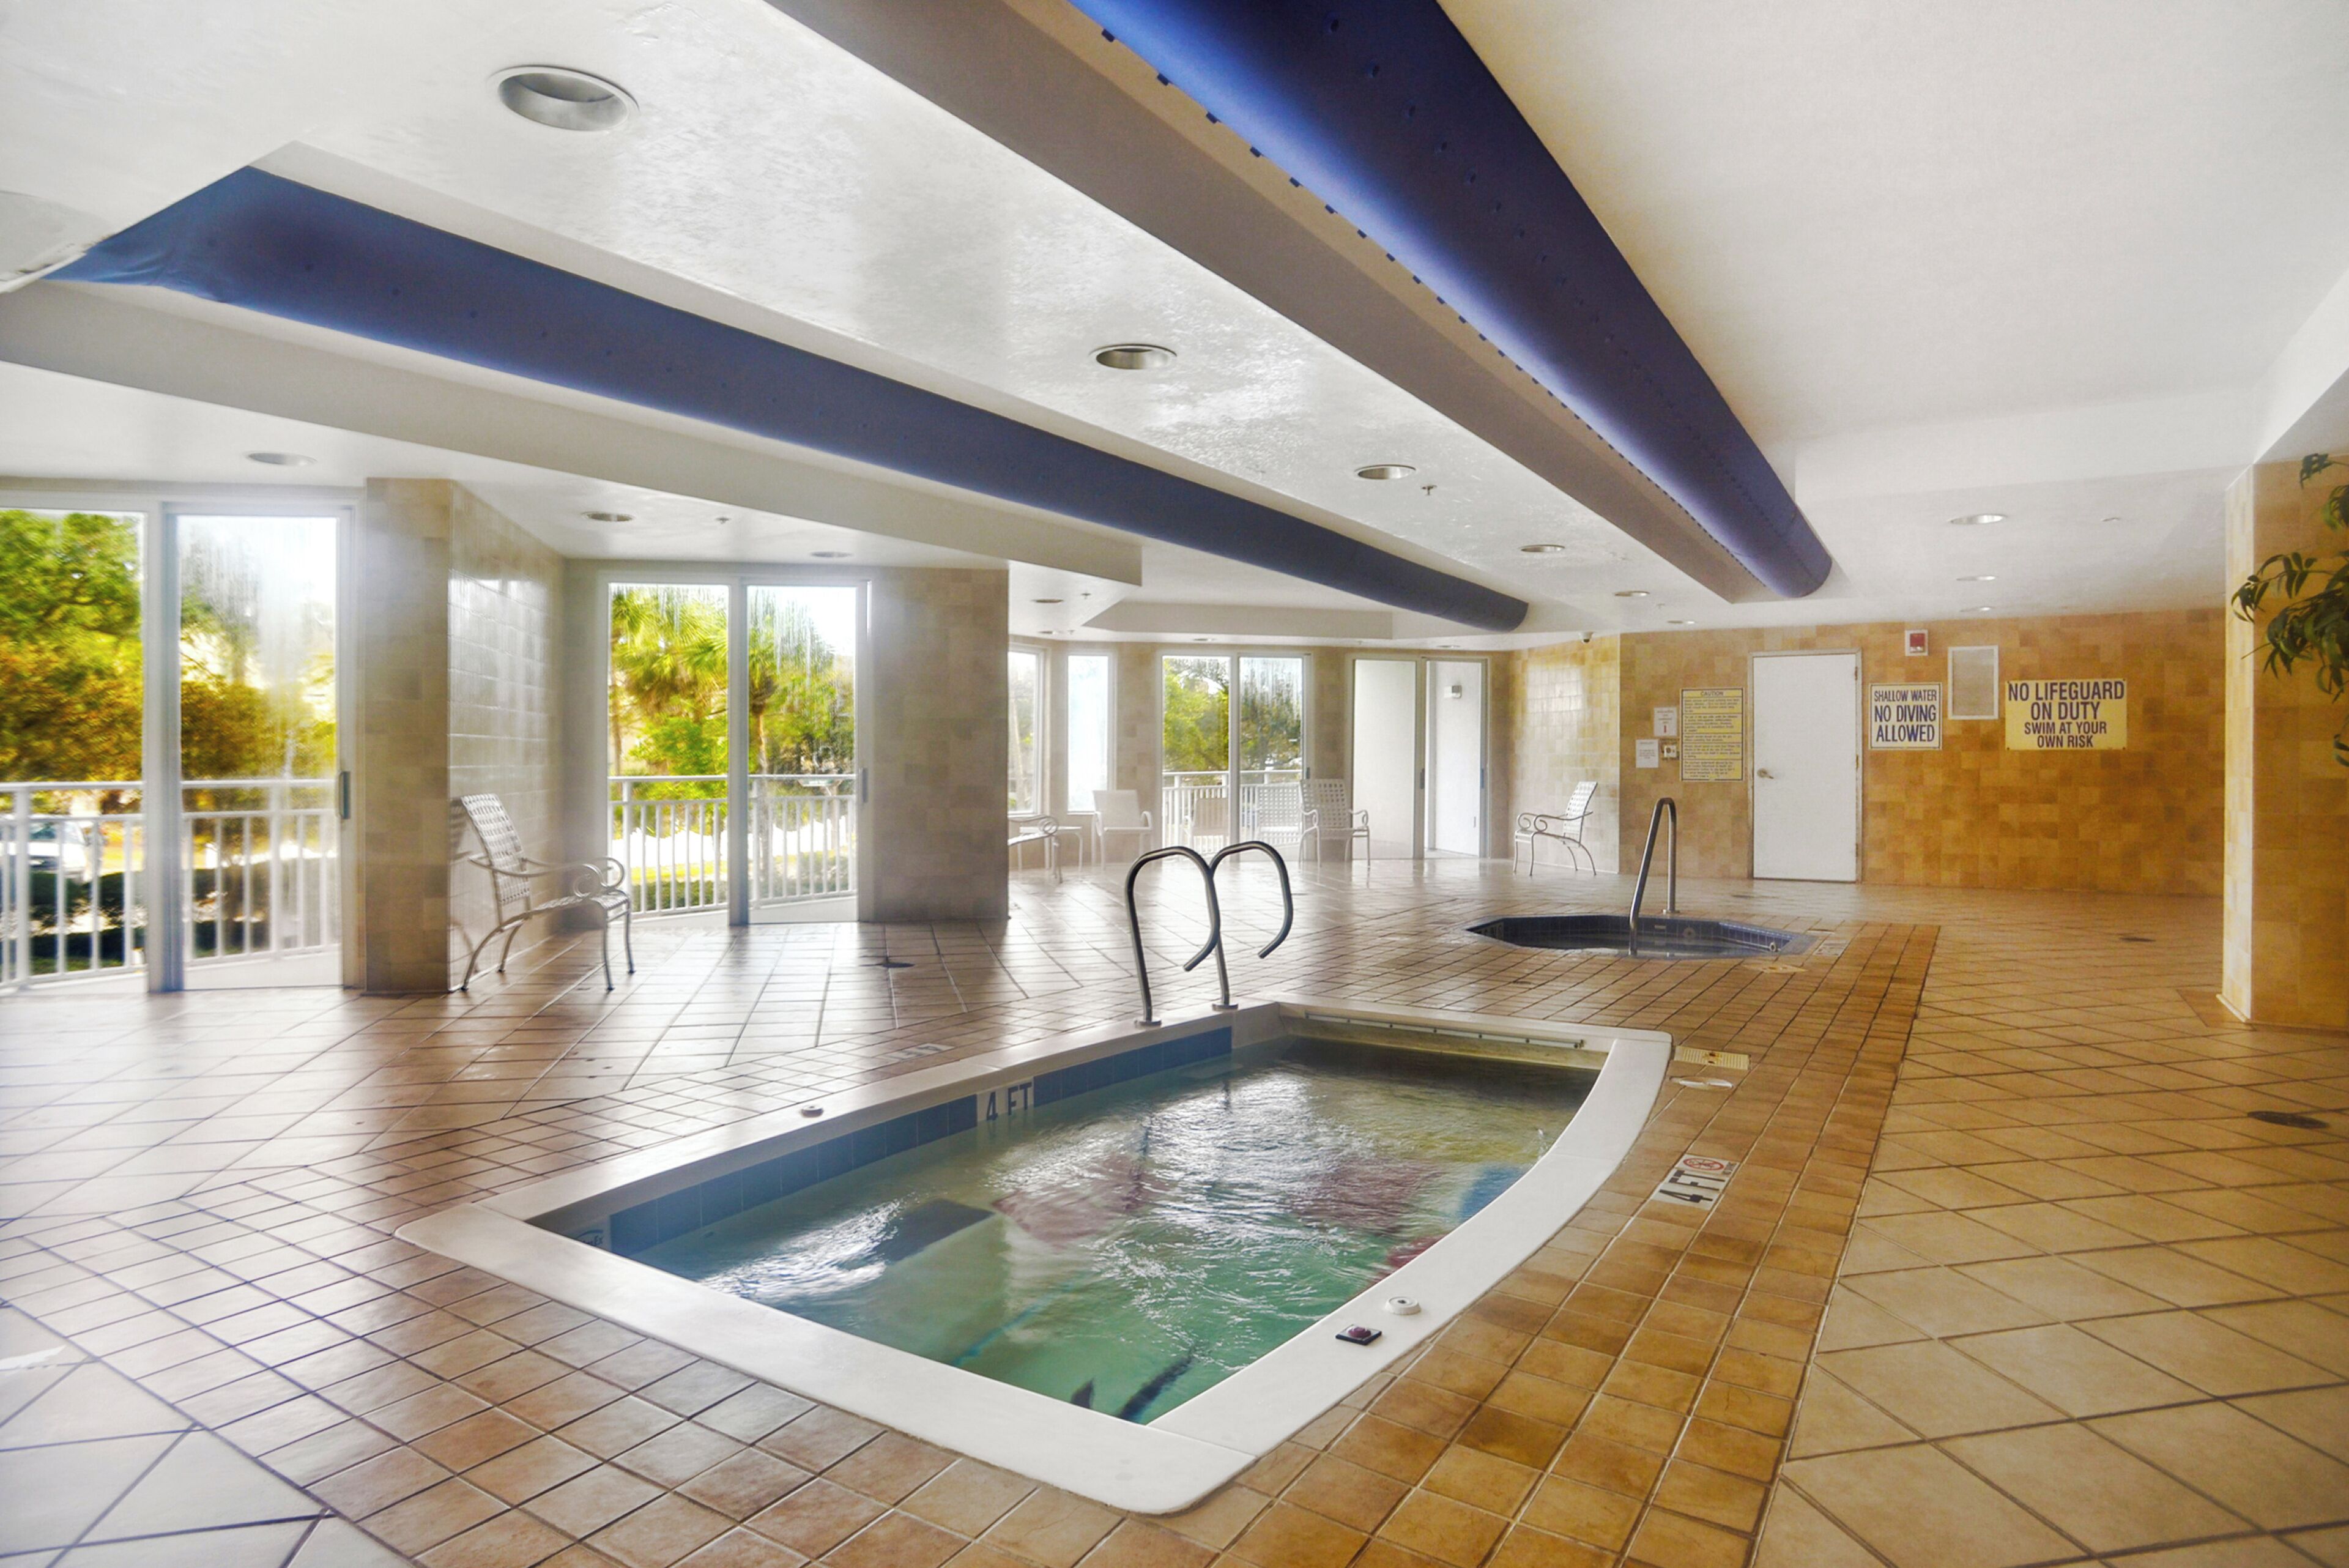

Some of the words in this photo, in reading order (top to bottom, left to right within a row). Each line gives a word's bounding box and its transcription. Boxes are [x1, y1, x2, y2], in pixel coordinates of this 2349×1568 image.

[1874, 690, 1909, 702] SHALLOW
[1910, 689, 1937, 701] WATER
[2008, 683, 2029, 701] NO
[2035, 681, 2124, 701] LIFEGUARD
[1874, 705, 1892, 723] NO
[1896, 704, 1936, 723] DIVING
[2031, 702, 2052, 720] ON
[2058, 701, 2101, 720] DUTY
[1876, 724, 1935, 742] ALLOWED
[2024, 722, 2055, 735] SWIM
[2059, 722, 2073, 734] AT
[2076, 721, 2107, 734] YOUR
[2038, 735, 2063, 748] OWN
[2067, 735, 2094, 748] RISK
[986, 1091, 999, 1121] 4
[1008, 1081, 1033, 1116] FT
[1668, 1170, 1726, 1192] FT
[1658, 1189, 1713, 1203] 4
